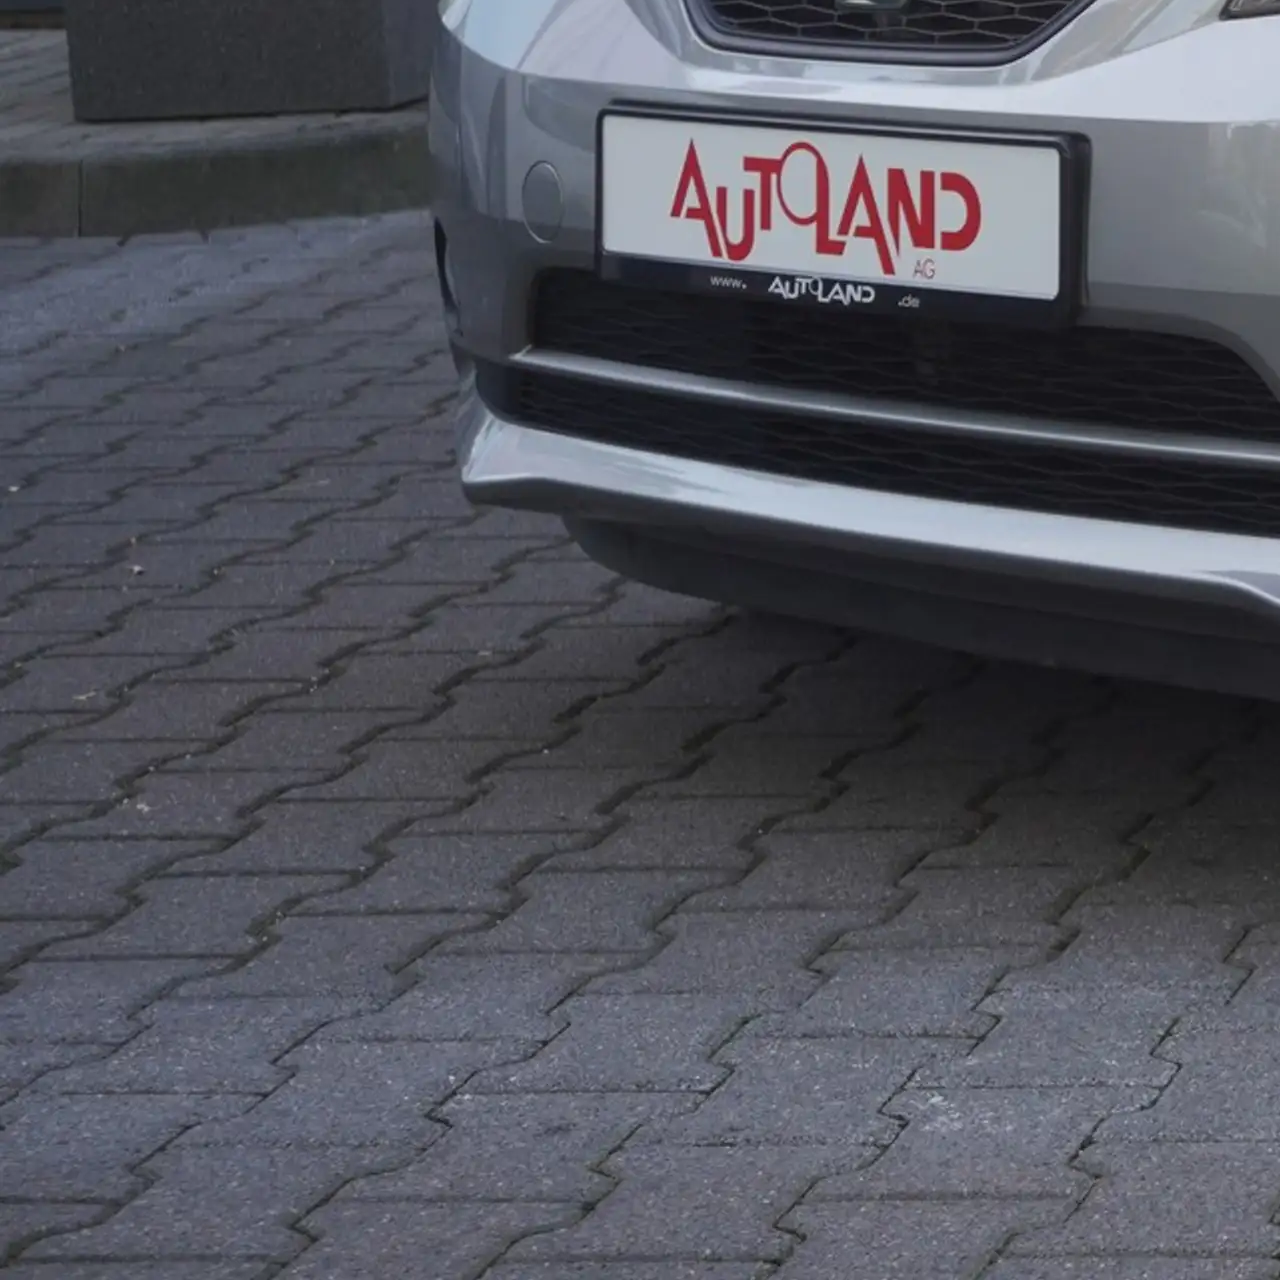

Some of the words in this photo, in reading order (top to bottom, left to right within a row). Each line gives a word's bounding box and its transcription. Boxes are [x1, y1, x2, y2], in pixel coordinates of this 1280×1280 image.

[669, 138, 982, 276] AUTOLAND
[912, 259, 936, 280] AG
[709, 274, 747, 290] www.
[768, 276, 876, 306] AUTOLAND
[897, 294, 920, 308] .de
